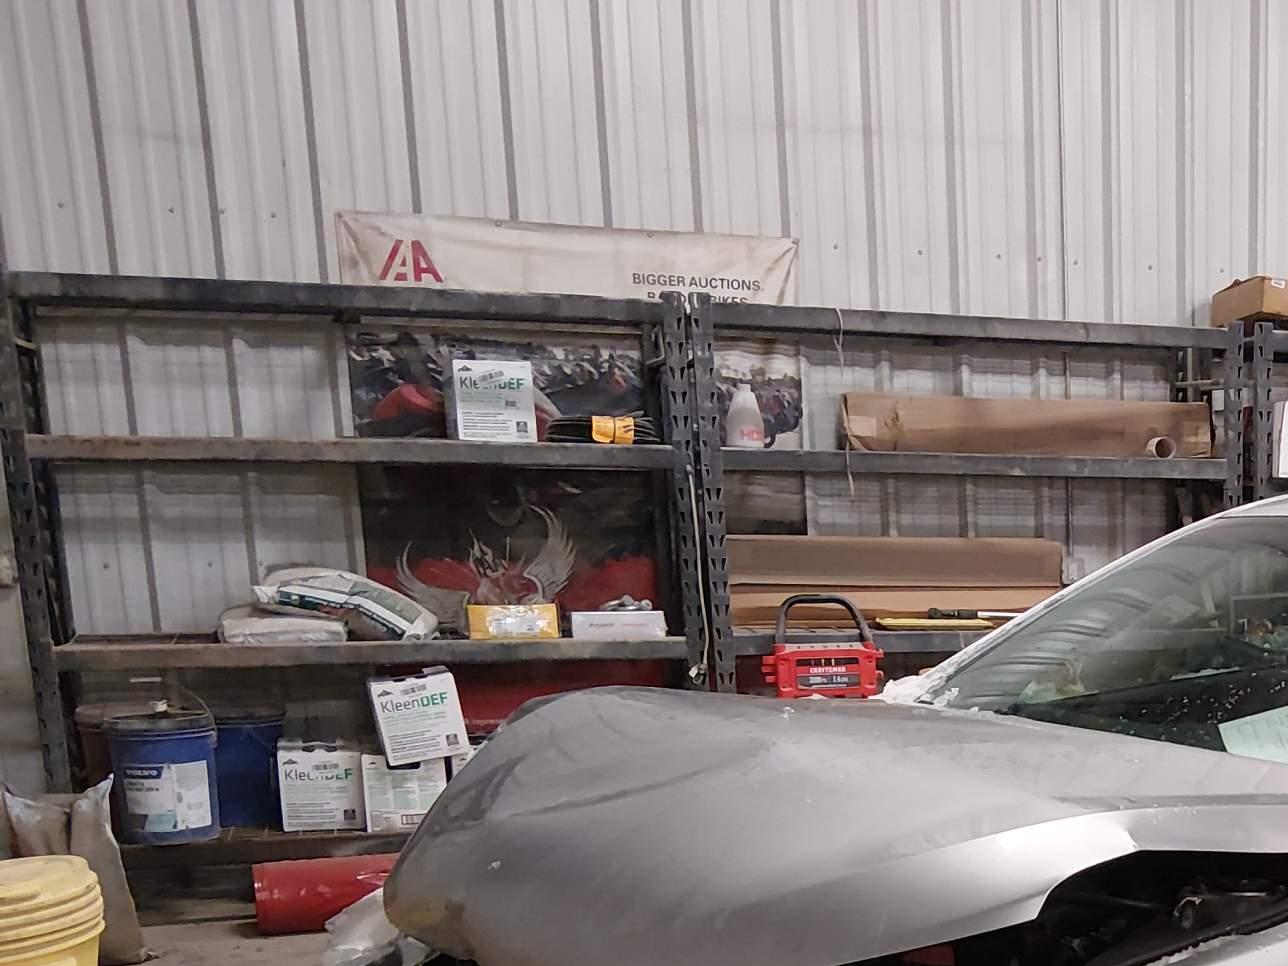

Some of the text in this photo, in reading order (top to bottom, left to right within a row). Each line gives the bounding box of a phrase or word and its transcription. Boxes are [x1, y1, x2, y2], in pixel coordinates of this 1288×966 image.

[379, 239, 444, 283] IAA
[632, 272, 765, 292] BIGGER AUCTIONS.
[380, 691, 448, 713] KleenDEF
